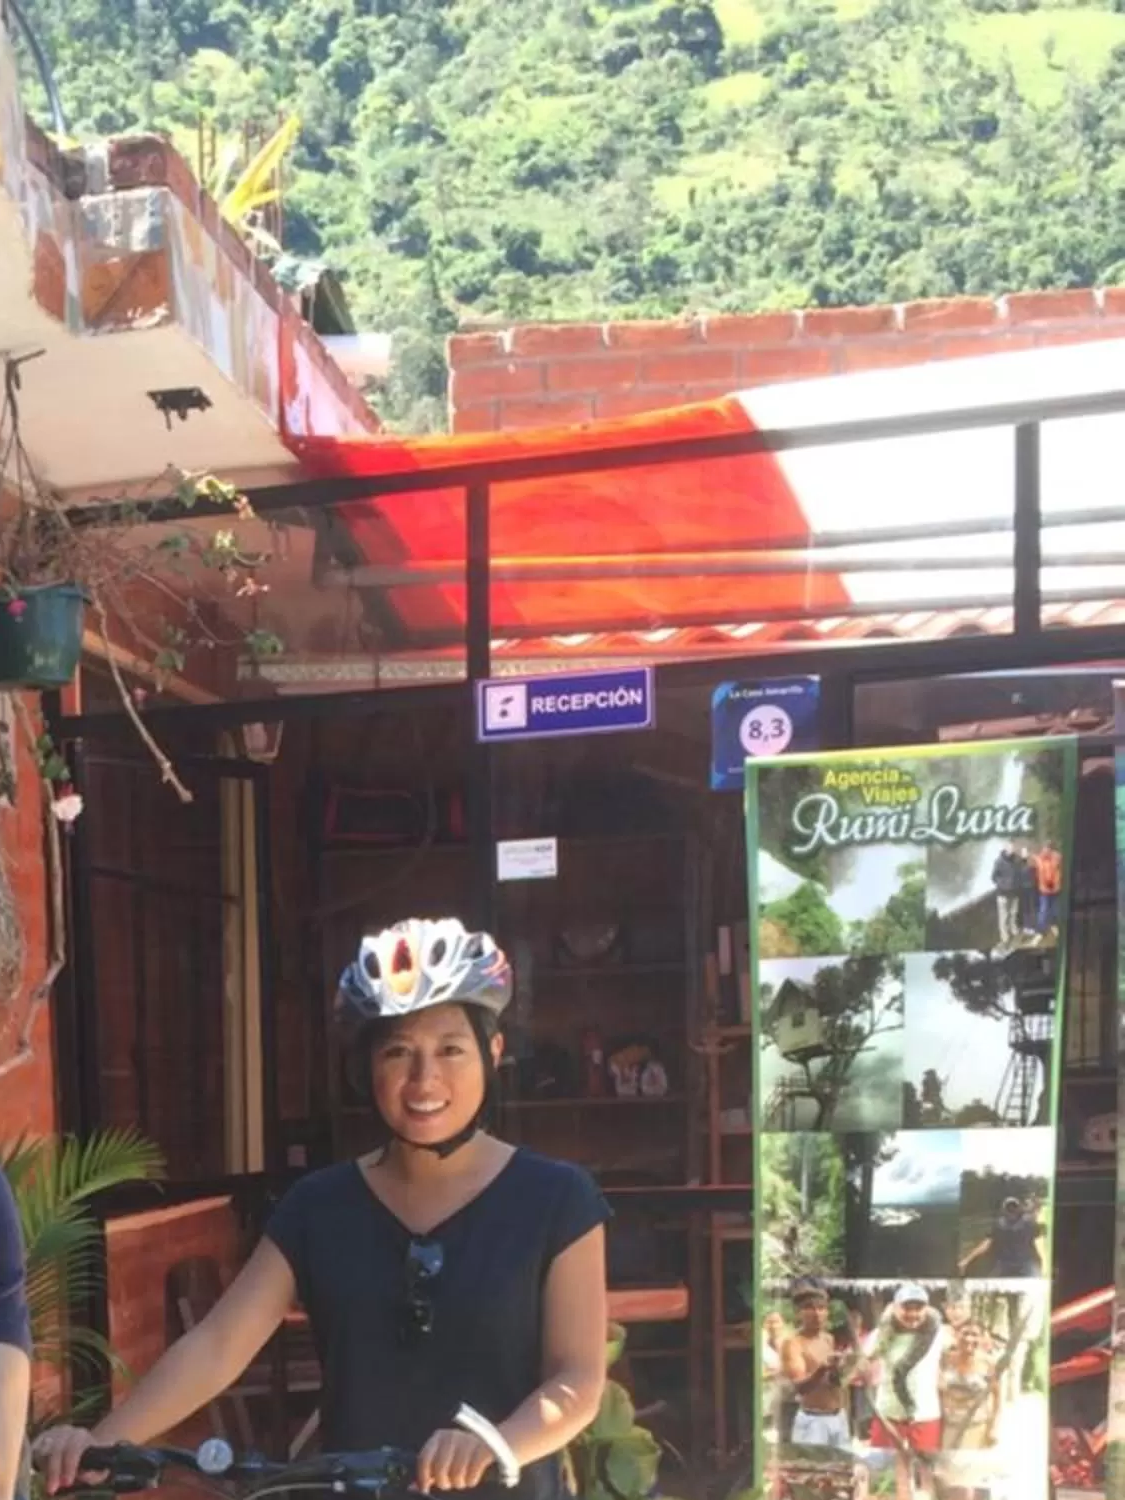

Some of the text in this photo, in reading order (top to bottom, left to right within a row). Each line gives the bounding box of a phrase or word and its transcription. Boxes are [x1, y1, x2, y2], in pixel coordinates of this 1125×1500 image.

[531, 686, 643, 714] RECEPCIÓN
[748, 718, 785, 742] 8,3
[824, 768, 899, 791] Agencia
[792, 785, 1033, 853] Rumi Luna
